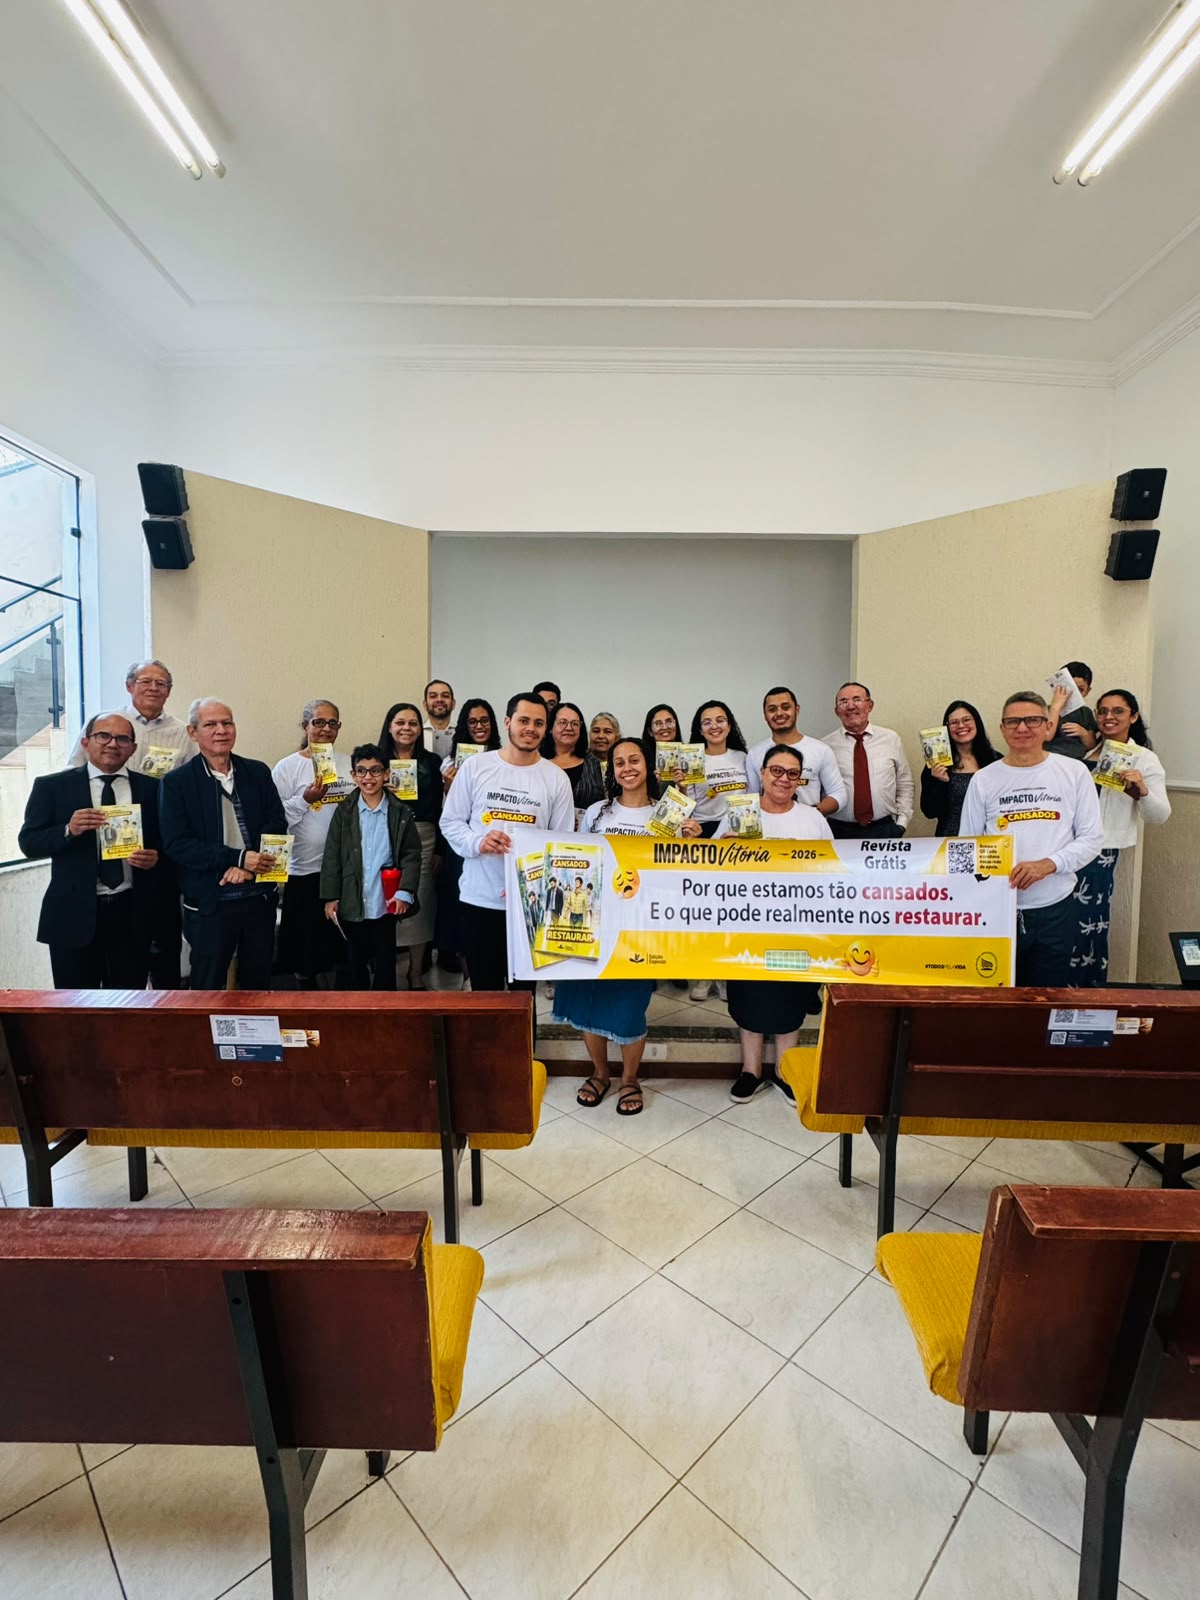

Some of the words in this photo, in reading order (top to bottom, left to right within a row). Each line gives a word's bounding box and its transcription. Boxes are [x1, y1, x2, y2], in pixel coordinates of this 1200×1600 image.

[486, 791, 518, 805] IMPACTO
[999, 793, 1034, 806] IMPACTO
[492, 812, 534, 823] CANSADOS
[1007, 811, 1057, 821] CANSADOS
[860, 840, 912, 852] Revista
[653, 842, 717, 864] IMPACTO
[717, 842, 772, 866] Vitória
[790, 849, 817, 860] 2026
[552, 859, 588, 868] CANSADOS
[864, 854, 907, 871] Grátis
[682, 878, 709, 898] Por
[715, 882, 748, 904] que
[752, 882, 825, 900] estamos
[829, 881, 857, 900] tão
[861, 881, 953, 902] cansados.
[650, 902, 660, 920] E
[664, 906, 675, 921] o
[680, 906, 713, 926] que
[717, 902, 761, 926] pode
[765, 904, 855, 924] realmente
[859, 910, 890, 925] nos
[894, 908, 987, 927] restaurar.
[547, 930, 593, 942] RESTAURAR
